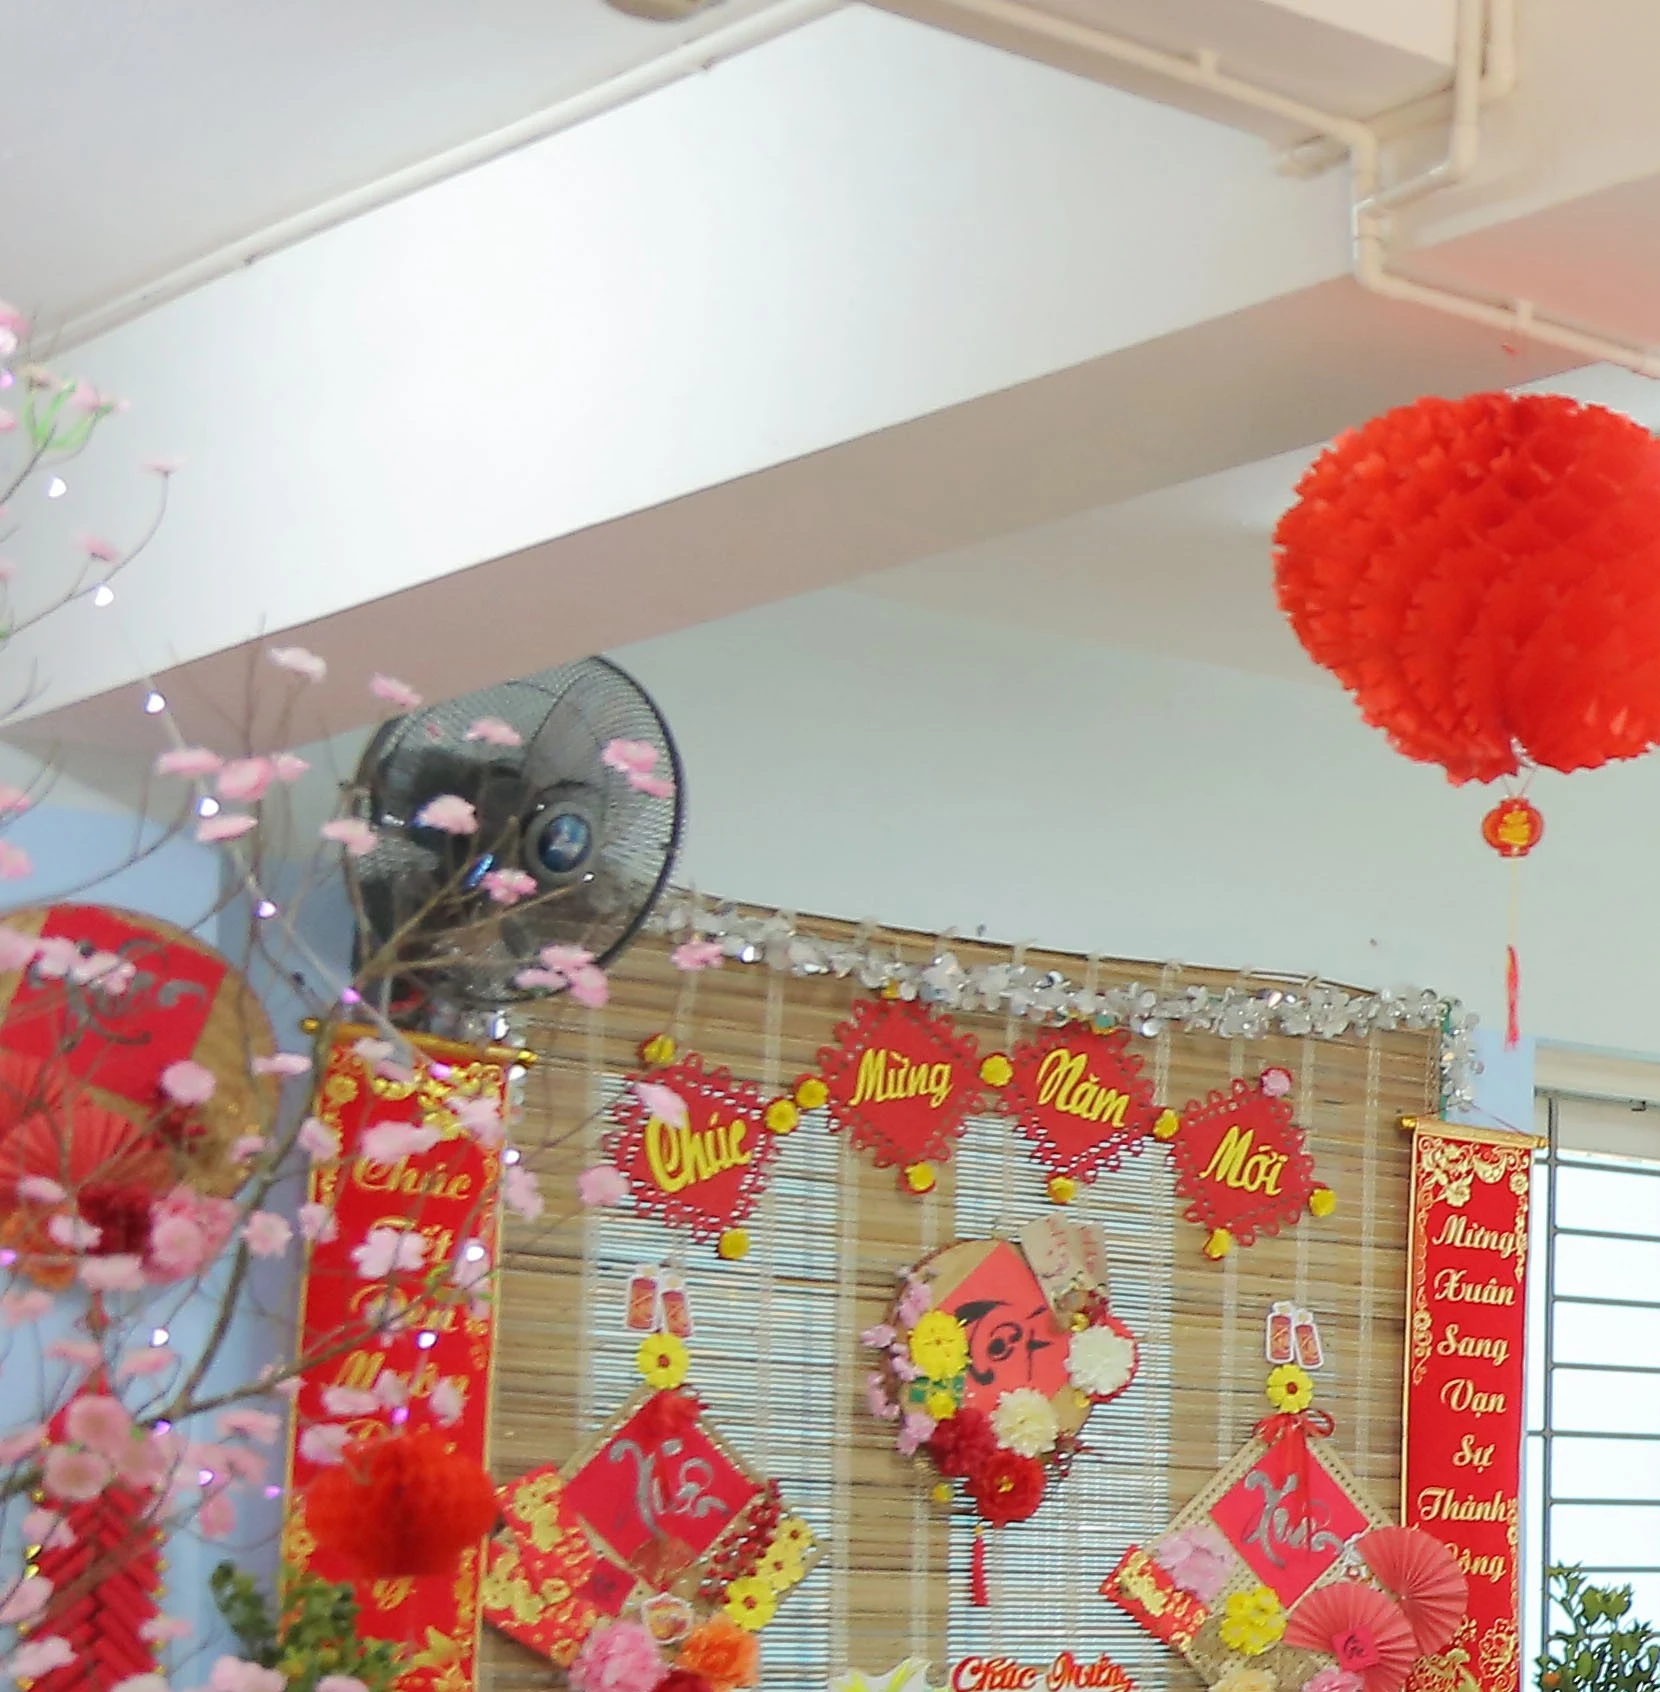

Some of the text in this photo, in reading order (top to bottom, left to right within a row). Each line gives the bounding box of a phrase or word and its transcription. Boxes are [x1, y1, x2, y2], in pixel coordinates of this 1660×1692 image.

[645, 1048, 1288, 1195] Chúc Mừng Năm Mới
[1431, 1214, 1516, 1259] Mừng
[1433, 1268, 1516, 1306] Xuân
[1436, 1324, 1510, 1367] Sang
[1440, 1378, 1507, 1419] Vạn
[1452, 1434, 1494, 1474] Sự
[1417, 1486, 1510, 1523] Thành
